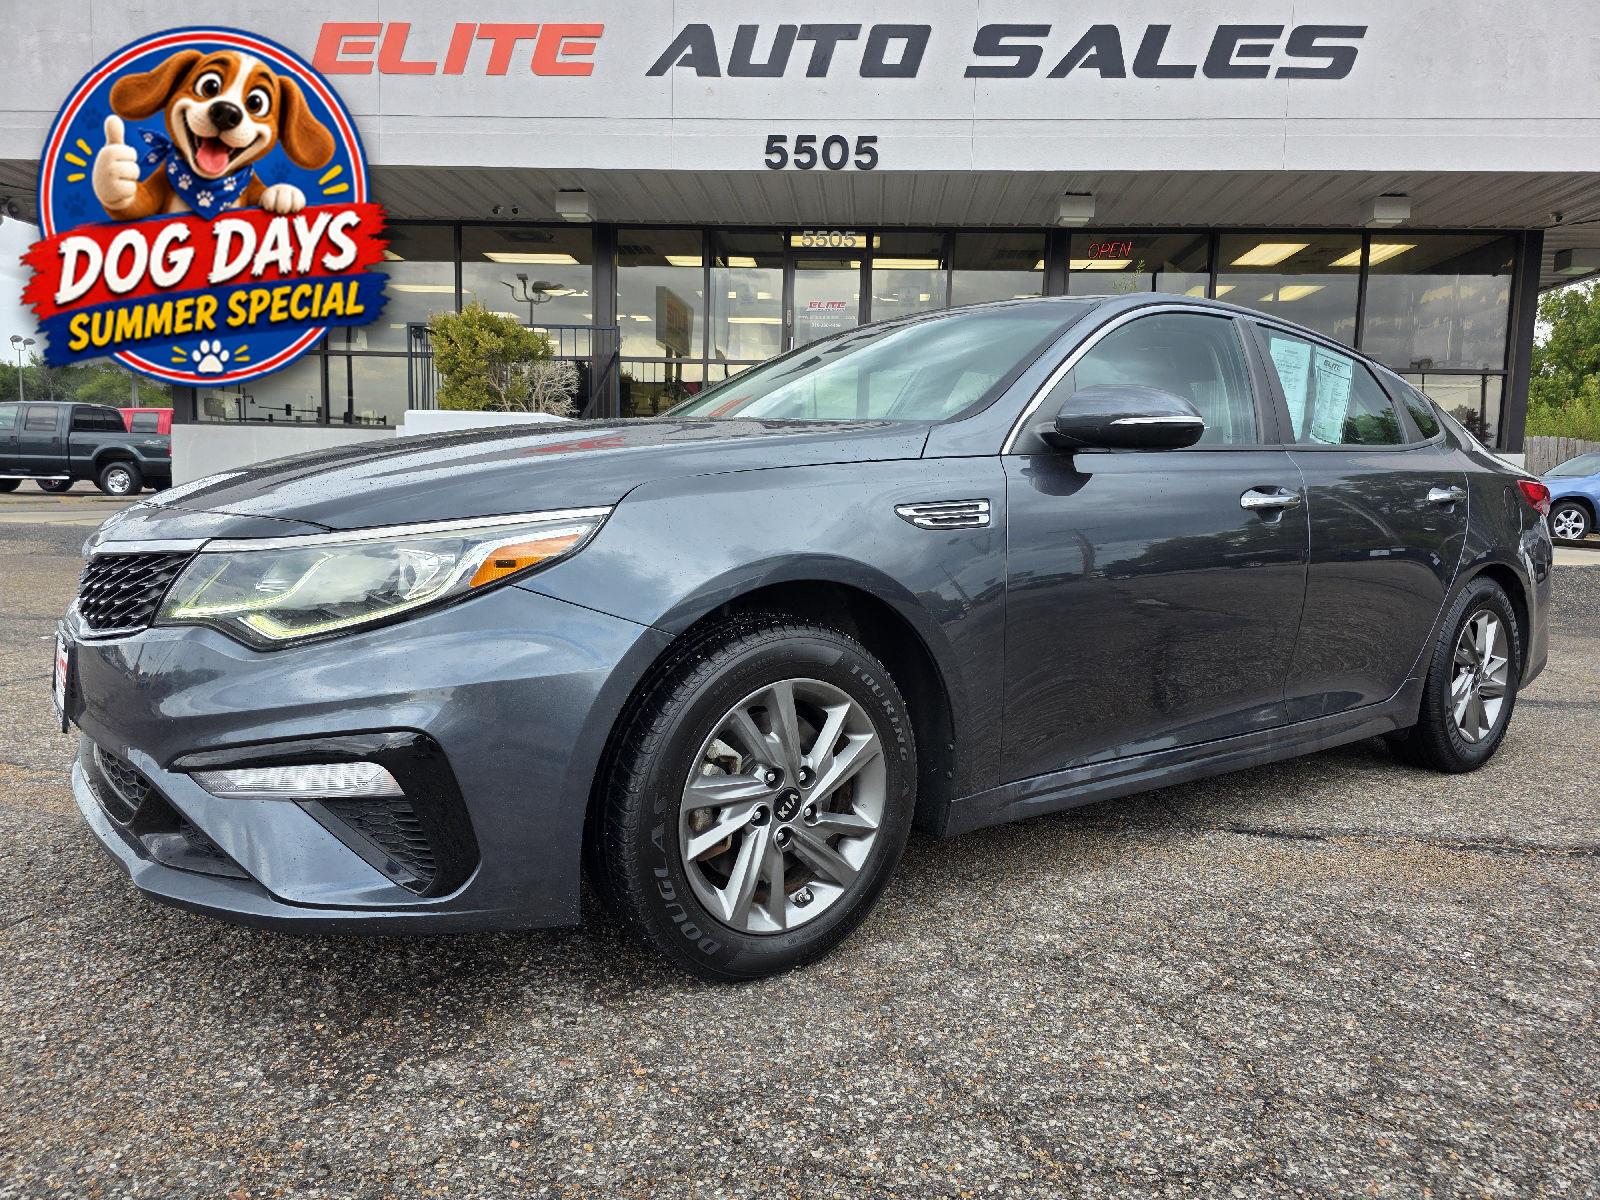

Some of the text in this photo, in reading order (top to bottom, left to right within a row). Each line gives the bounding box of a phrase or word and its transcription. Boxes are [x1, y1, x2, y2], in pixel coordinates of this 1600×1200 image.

[311, 22, 1368, 79] ELITE AUTO SALES
[764, 134, 878, 170] 5505
[801, 230, 857, 248] 5505
[1088, 241, 1132, 259] OPEN
[809, 301, 847, 309] ELITE
[849, 663, 909, 761] TOURING
[777, 793, 799, 819] KIA
